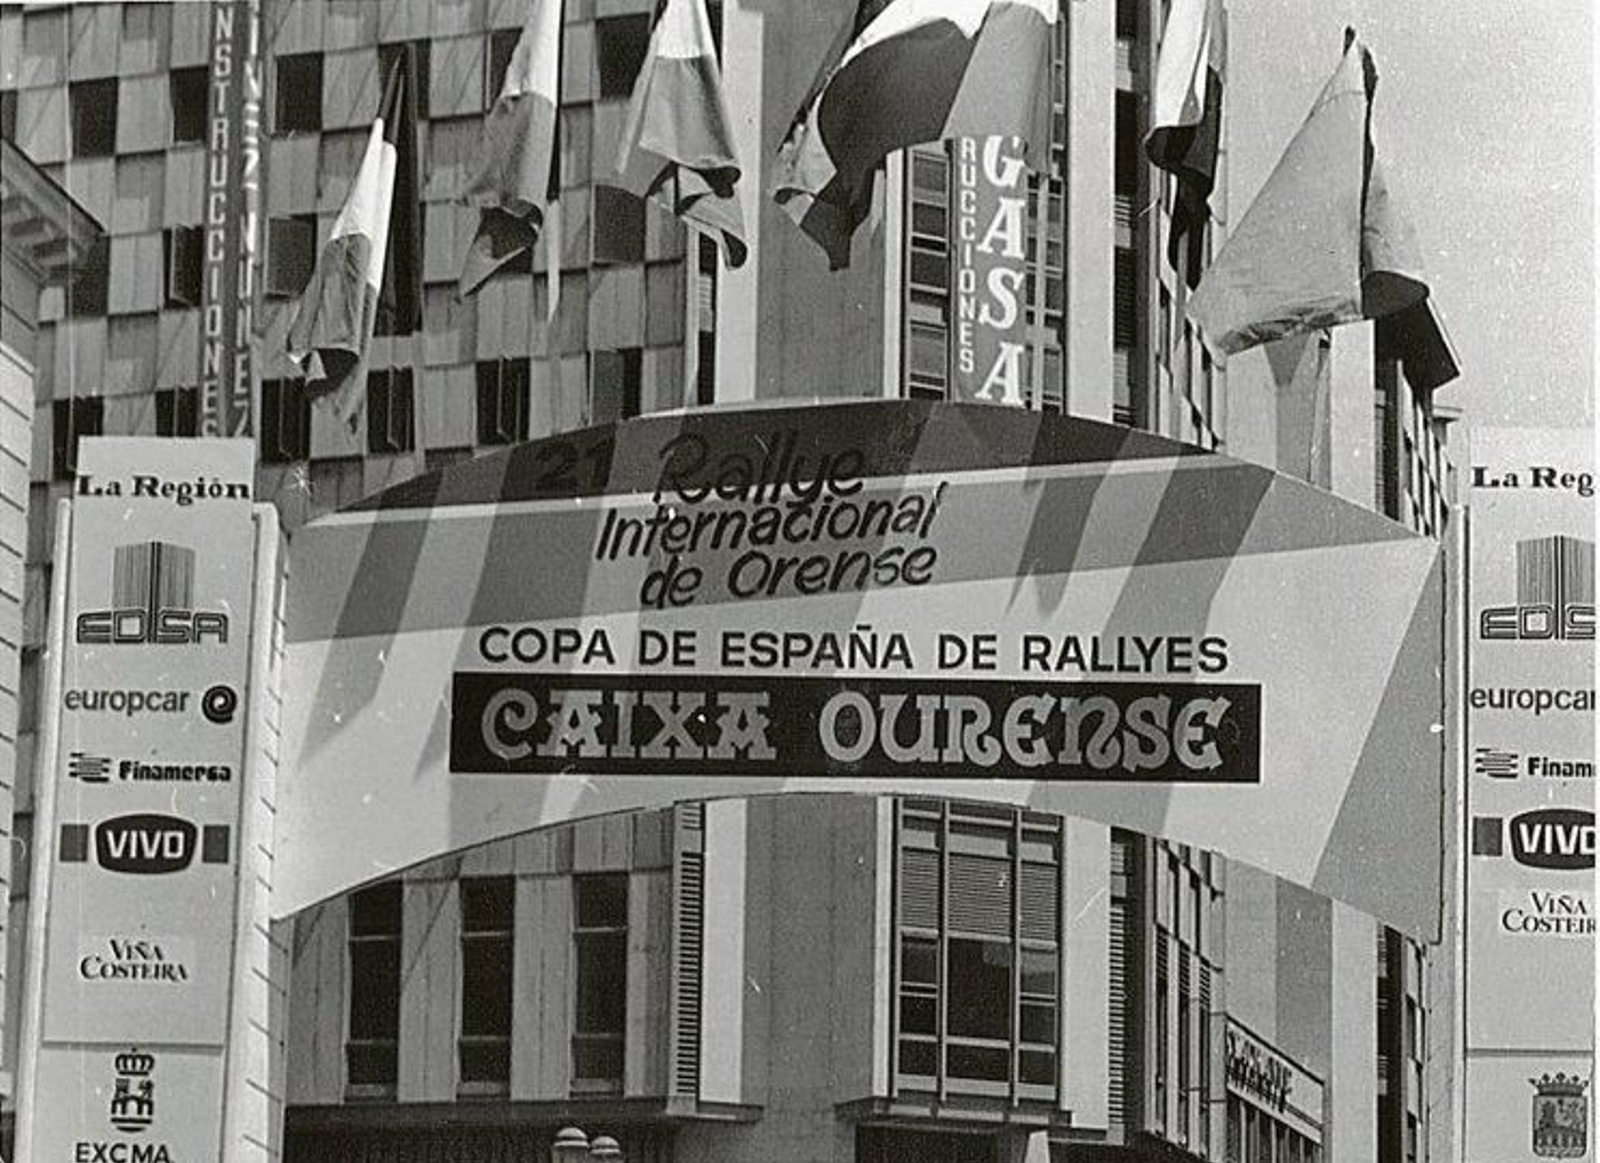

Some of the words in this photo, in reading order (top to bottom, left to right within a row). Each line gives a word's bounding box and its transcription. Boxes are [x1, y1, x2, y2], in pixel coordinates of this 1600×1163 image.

[653, 432, 865, 505] Rallye
[1472, 466, 1519, 488] La
[1529, 466, 1595, 498] Reg
[78, 475, 121, 496] La
[132, 475, 250, 506] Región
[596, 481, 948, 560] Internacional
[638, 555, 703, 610] de
[727, 546, 938, 598] Orense
[76, 609, 229, 645] EDISA
[479, 627, 615, 665] COPA
[638, 630, 697, 667] DE
[720, 625, 914, 669] ESPAÑA
[937, 633, 998, 671] DE
[1021, 635, 1229, 673] RALLYES
[64, 688, 190, 717] europcar
[481, 688, 778, 761] CAIXA
[818, 690, 1232, 772] OURENSE
[119, 760, 232, 782] Finamersa
[1527, 756, 1595, 778] Finam
[105, 829, 186, 860] VIVO
